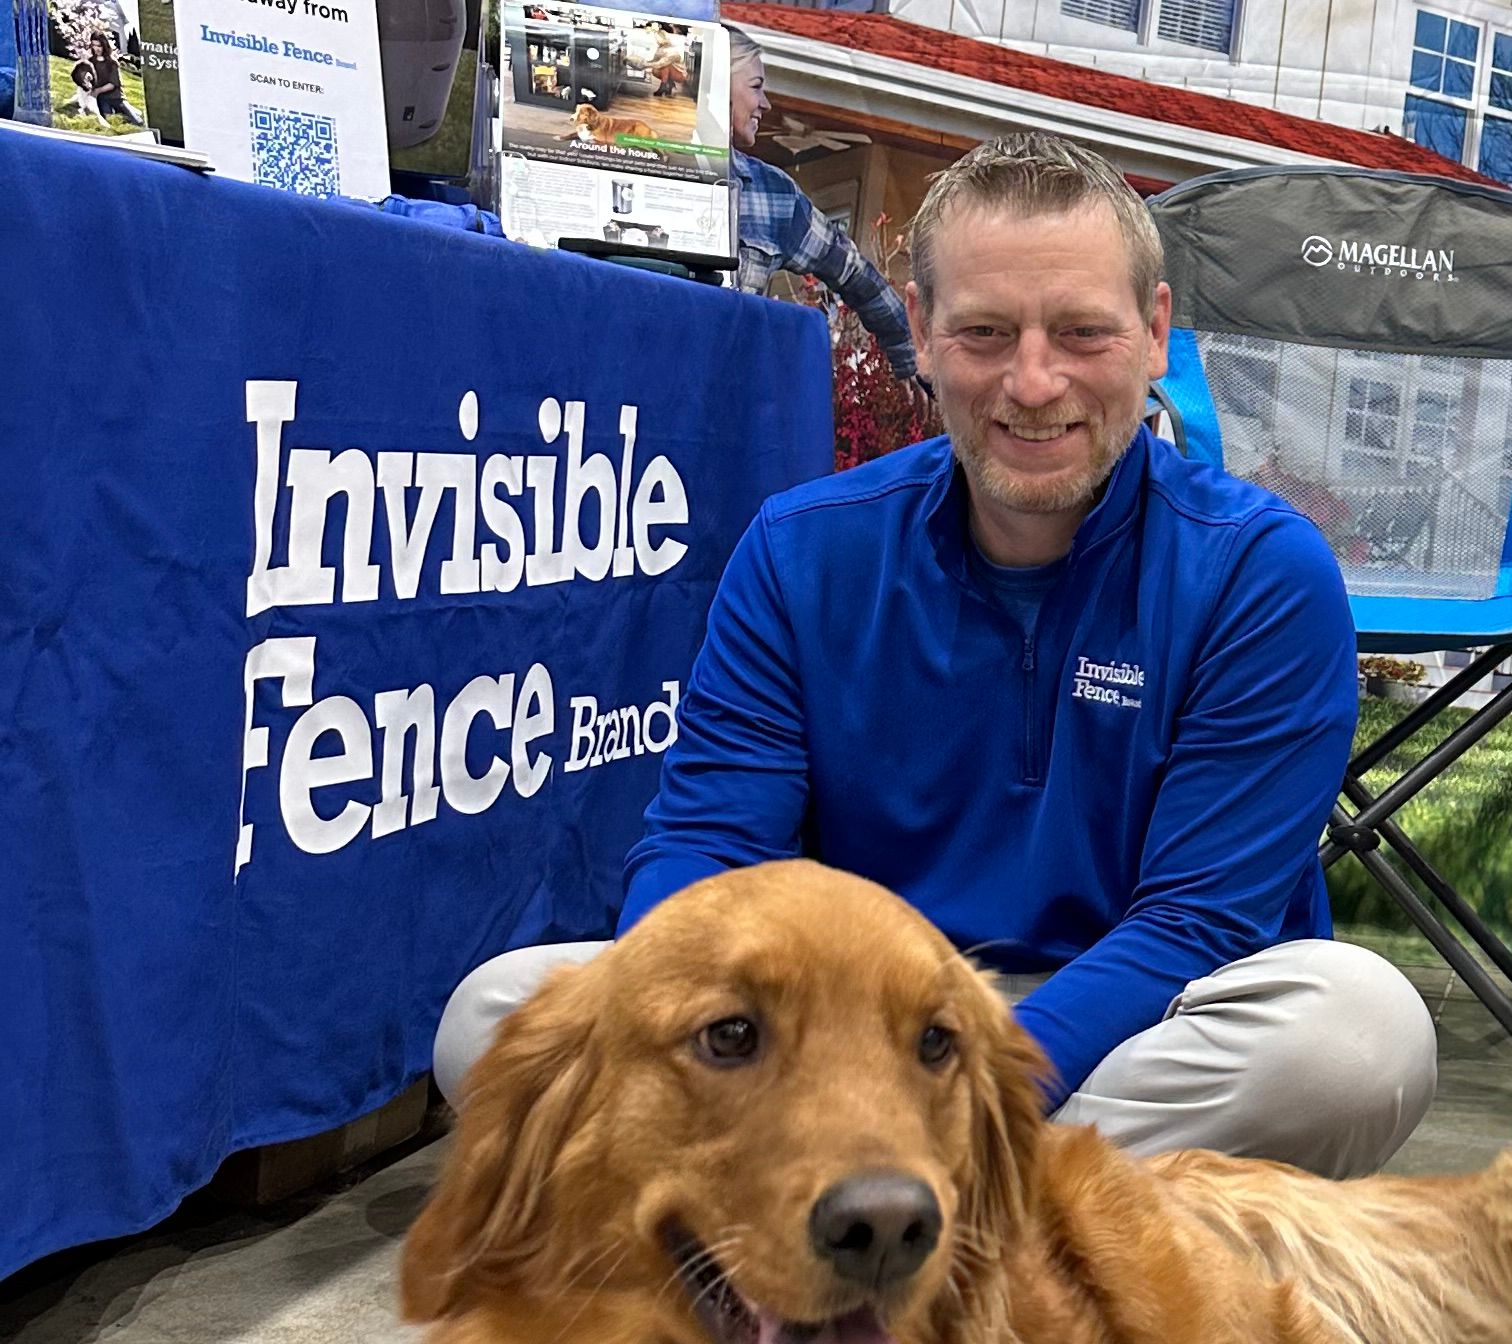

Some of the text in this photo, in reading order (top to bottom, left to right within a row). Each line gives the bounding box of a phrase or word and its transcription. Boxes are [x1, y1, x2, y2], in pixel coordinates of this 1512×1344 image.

[200, 24, 279, 55] Invisible
[282, 40, 333, 65] Fence
[249, 73, 276, 85] SCAN
[277, 78, 290, 88] TO
[569, 139, 608, 153] Around
[609, 145, 626, 156] the
[1338, 240, 1455, 272] MAGELLAN
[1337, 262, 1455, 282] OUTDOORS
[245, 379, 690, 618] Invisible
[1075, 656, 1144, 687] Invisible
[1072, 678, 1120, 704] Fence
[234, 636, 680, 885] Fence Brand
